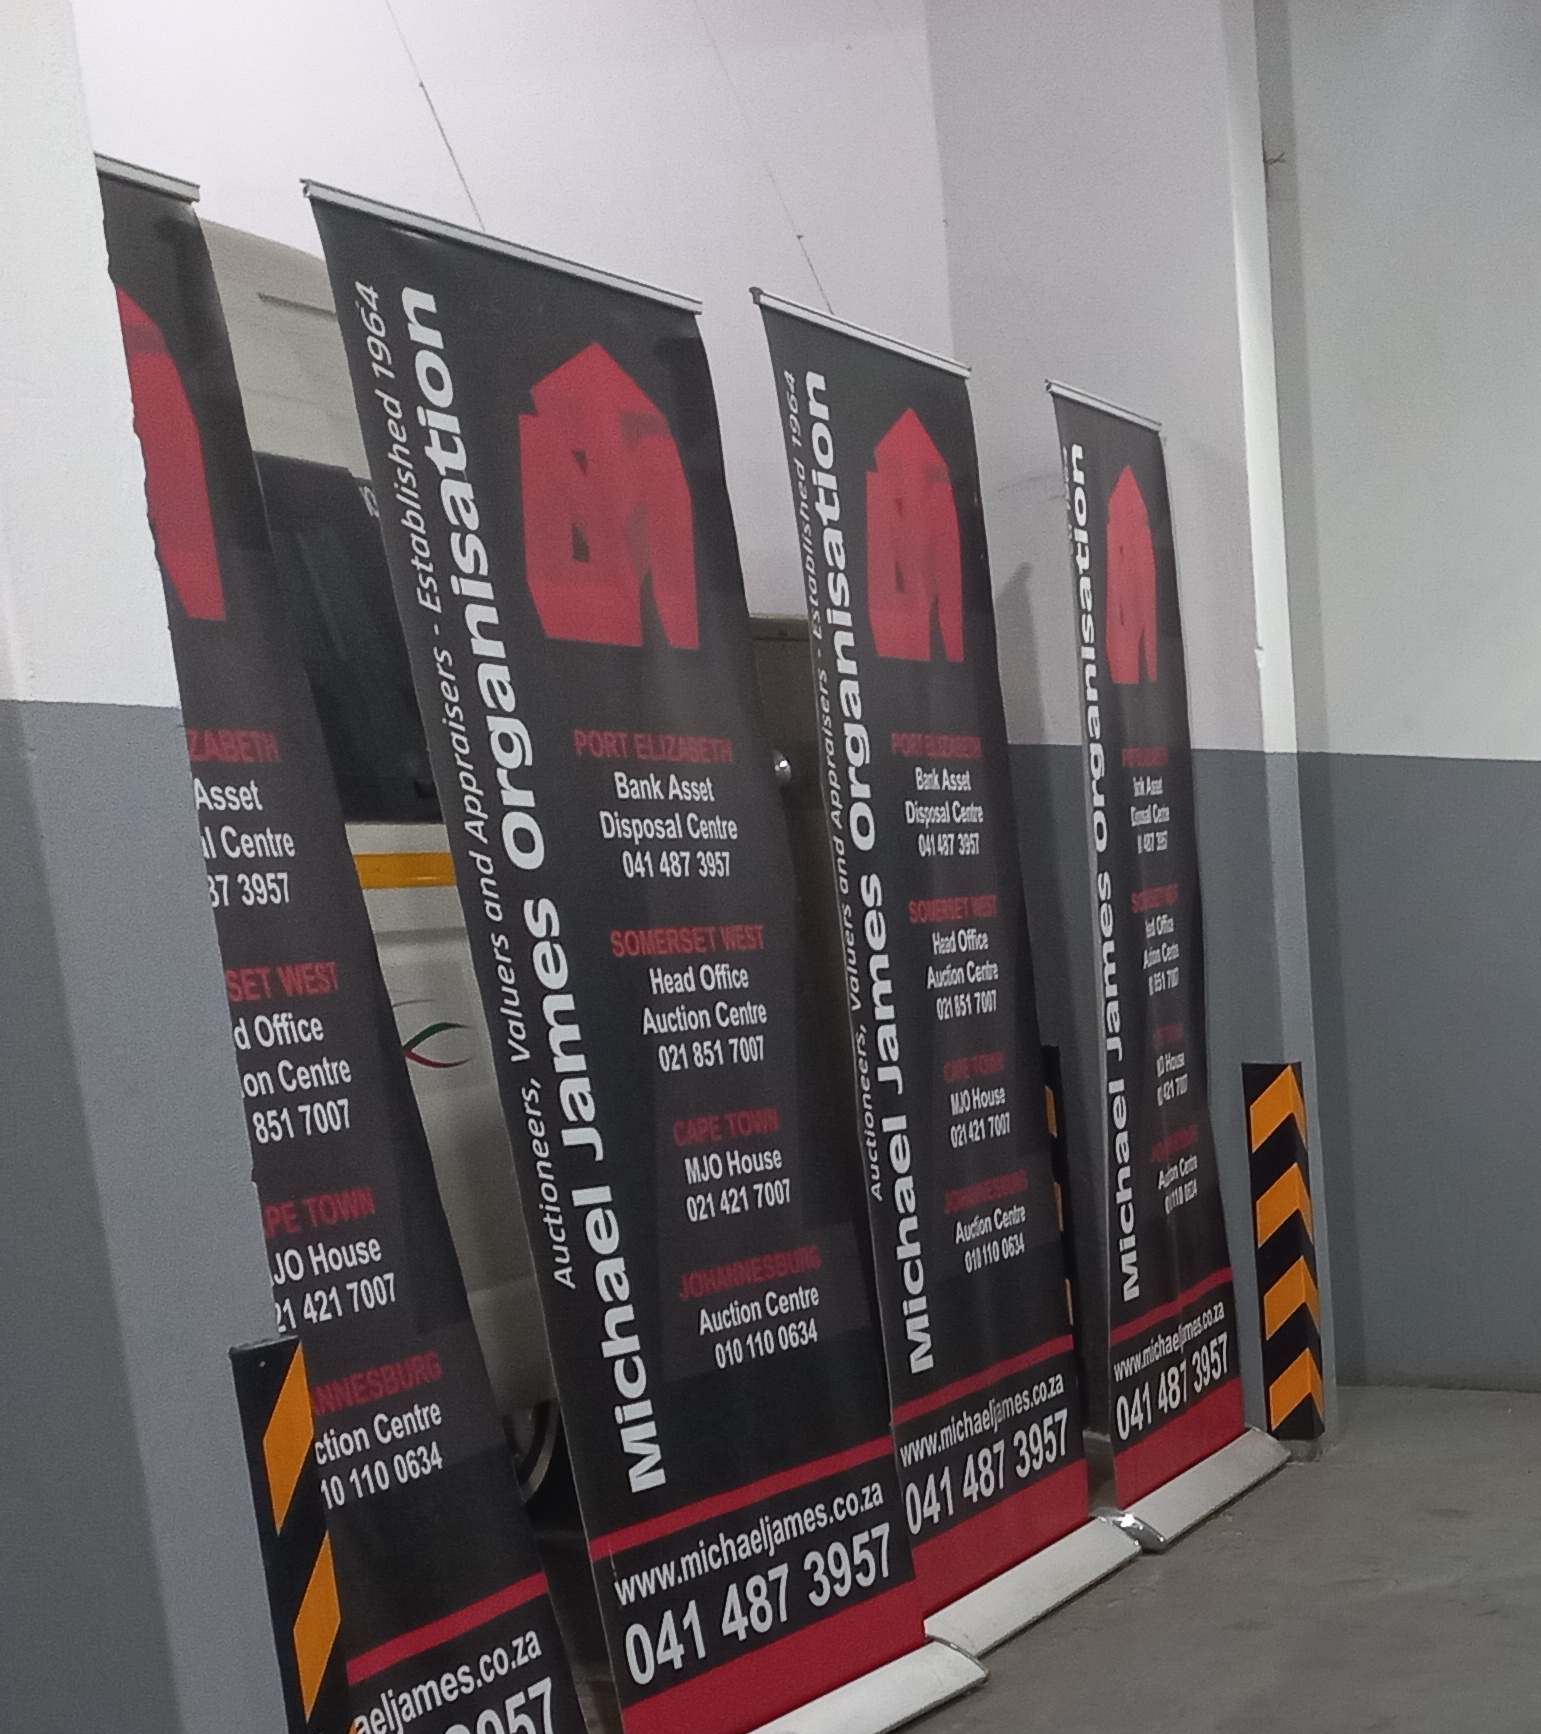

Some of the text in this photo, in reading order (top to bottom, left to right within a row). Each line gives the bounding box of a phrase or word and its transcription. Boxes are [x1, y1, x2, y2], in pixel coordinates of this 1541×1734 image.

[355, 281, 395, 379] 1964
[374, 388, 442, 614] Established
[433, 645, 489, 844] Appraisers
[574, 729, 628, 758] PORT
[817, 668, 843, 830] Appraisers
[194, 777, 263, 811] Asset
[614, 771, 715, 802] Bank Asset
[941, 768, 972, 791] Asset
[599, 810, 738, 845] Disposal Centre
[904, 800, 984, 829] Disposal Centre
[221, 825, 296, 858] Centre
[622, 850, 730, 878] 041 487 3957
[805, 370, 934, 1375] Michael James Organisation
[831, 837, 850, 895] and
[1072, 443, 1140, 1302] Michael James Organisation
[237, 872, 290, 906] 3957
[402, 286, 666, 1493] Michael James Organisation
[469, 851, 503, 922] and
[610, 924, 764, 958] SOMERSET WEST
[957, 928, 989, 953] Office
[278, 961, 339, 997] WEST
[649, 963, 749, 995] Head Office
[927, 960, 999, 989] Auction Centre
[491, 934, 531, 1063] Valuers
[642, 1001, 767, 1035] Auction Centre
[254, 1012, 324, 1048] Office
[277, 1056, 352, 1092] Centre
[658, 1035, 764, 1072] 021 851 7007
[971, 1086, 1006, 1110] House
[252, 1098, 350, 1144] 851 7007
[520, 1078, 576, 1289] Auctioneers,
[684, 1149, 783, 1185] MJO House
[304, 1187, 376, 1227] TOWN
[686, 1178, 791, 1222] 021 421 7007
[955, 1204, 1027, 1245] Auction Centre
[307, 1238, 382, 1276] House
[303, 1286, 343, 1325] 421
[346, 1272, 396, 1313] 7007
[700, 1286, 820, 1336] Auction Centre
[715, 1318, 818, 1369] 010 110 0634
[1116, 1331, 1228, 1441] 041 487 3957
[373, 1402, 442, 1444] Centre
[900, 1373, 1065, 1468] www.michaeljames.co.za
[350, 1460, 390, 1499] 110
[393, 1441, 443, 1484] 0634
[904, 1408, 1069, 1536] 041 487 3957
[613, 1481, 884, 1607] www.michaeljames.co.za
[625, 1522, 891, 1685] 041 487 3957
